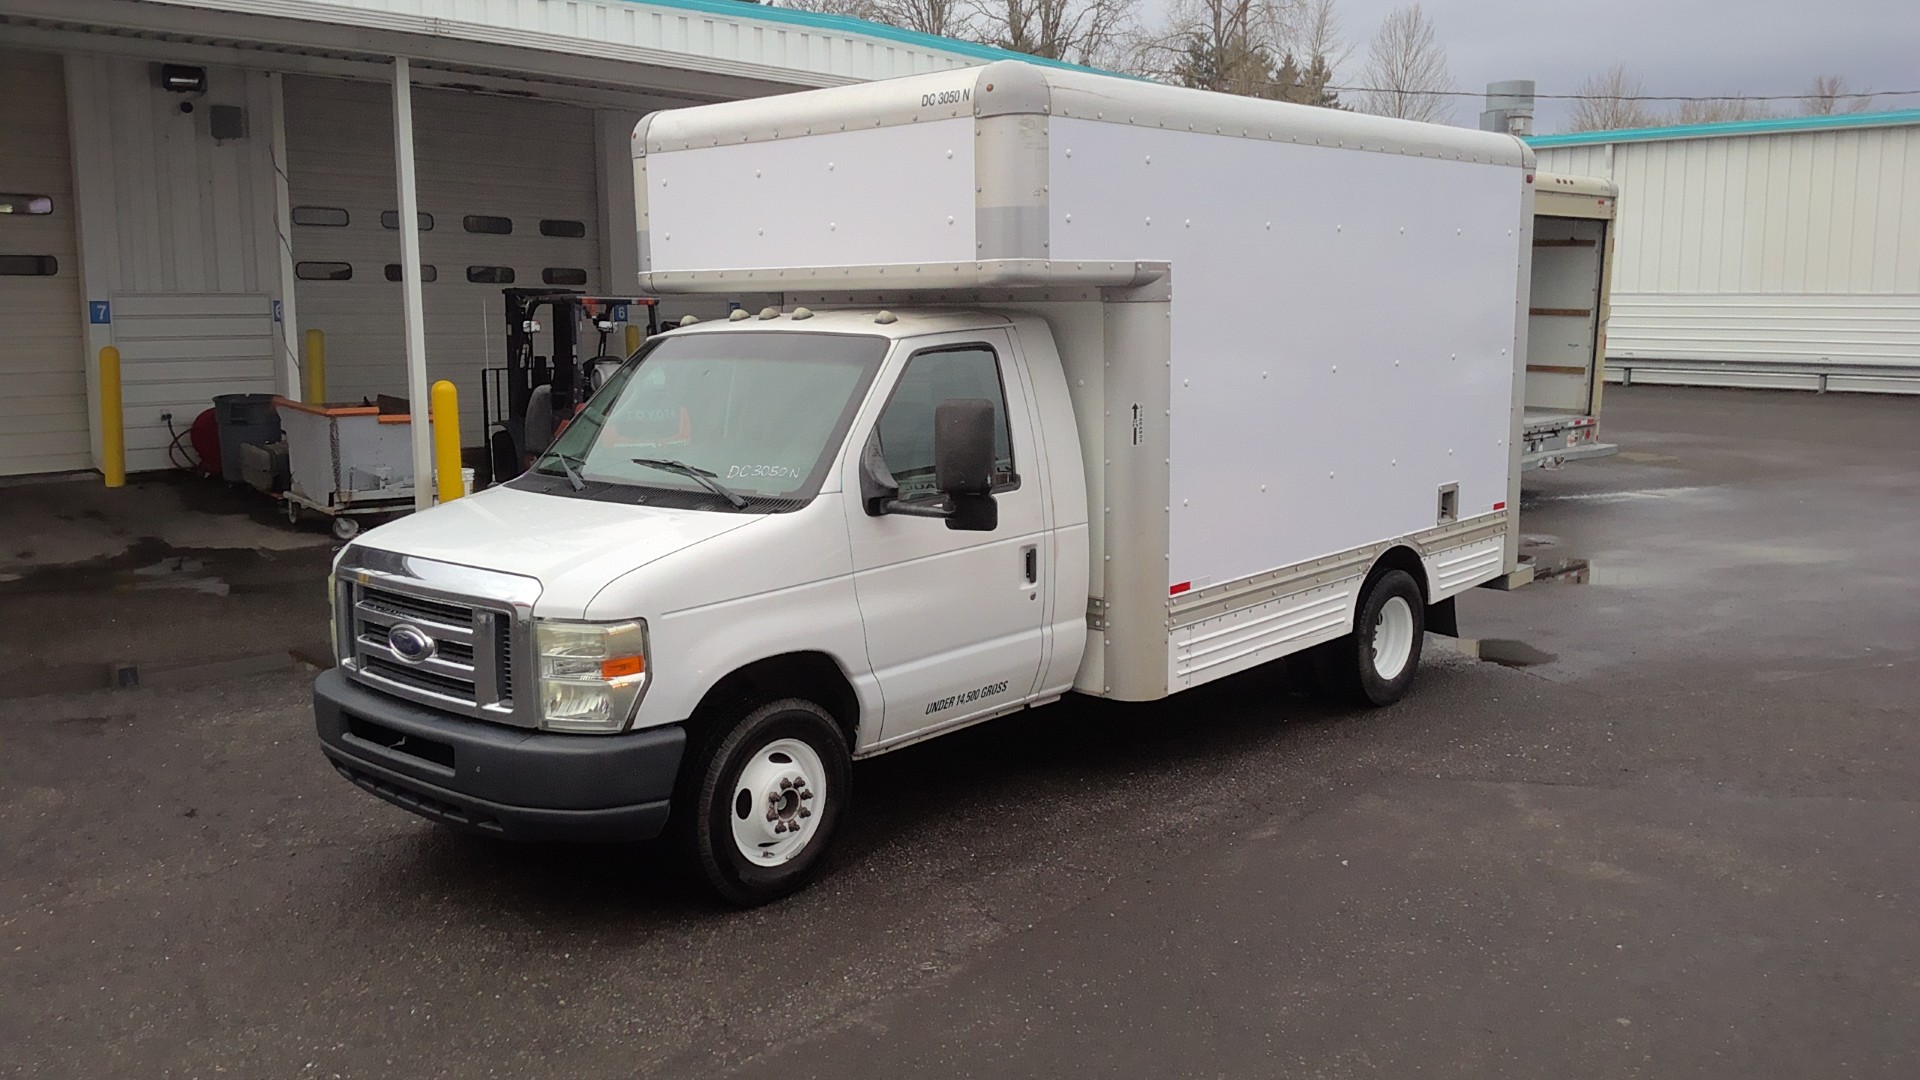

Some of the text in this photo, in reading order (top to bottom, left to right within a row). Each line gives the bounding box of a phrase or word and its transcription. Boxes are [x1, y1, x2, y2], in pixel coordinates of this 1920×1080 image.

[921, 88, 971, 107] DC 3050 N
[96, 304, 107, 320] 7
[618, 306, 626, 319] 6
[925, 680, 1008, 715] UNDER 14,500 GROSS
